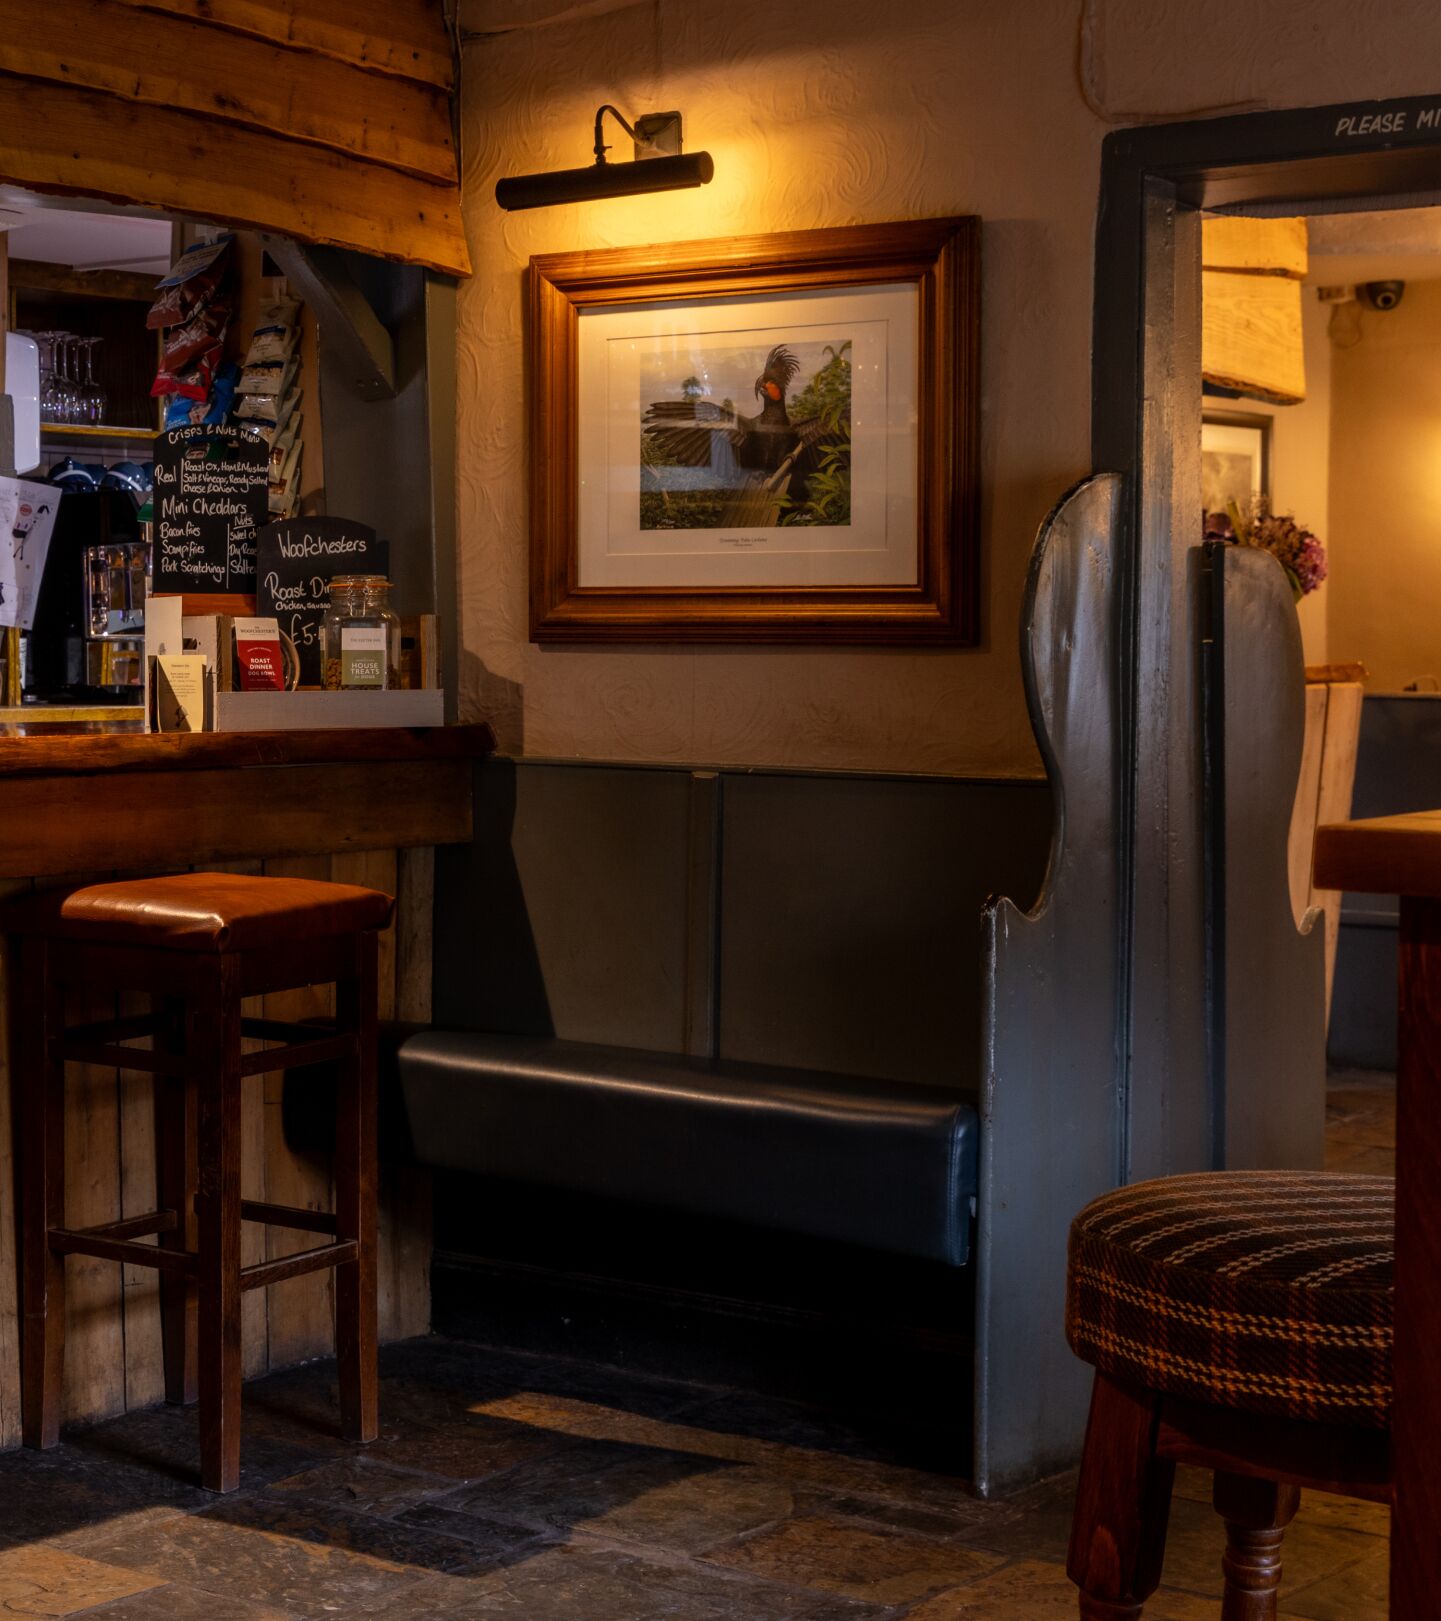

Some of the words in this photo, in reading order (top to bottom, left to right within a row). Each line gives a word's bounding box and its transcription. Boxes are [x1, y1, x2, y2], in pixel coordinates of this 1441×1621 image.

[1335, 112, 1406, 136] PLEASE
[1416, 108, 1441, 130] MI
[168, 427, 203, 445] Crisps
[216, 425, 237, 436] Nuts
[240, 430, 260, 443] Menu
[154, 464, 176, 486] Real
[184, 460, 204, 472] Roast
[229, 474, 250, 493] Ready
[162, 495, 188, 520] Mini
[192, 498, 247, 516] Cheddars
[160, 521, 185, 539] Bacon
[234, 516, 253, 526] Nuts
[278, 530, 367, 558] Woofchesters
[161, 556, 178, 574] Pork
[180, 560, 226, 583] Scratchings
[230, 560, 256, 574] Salte
[264, 572, 307, 600] Roast
